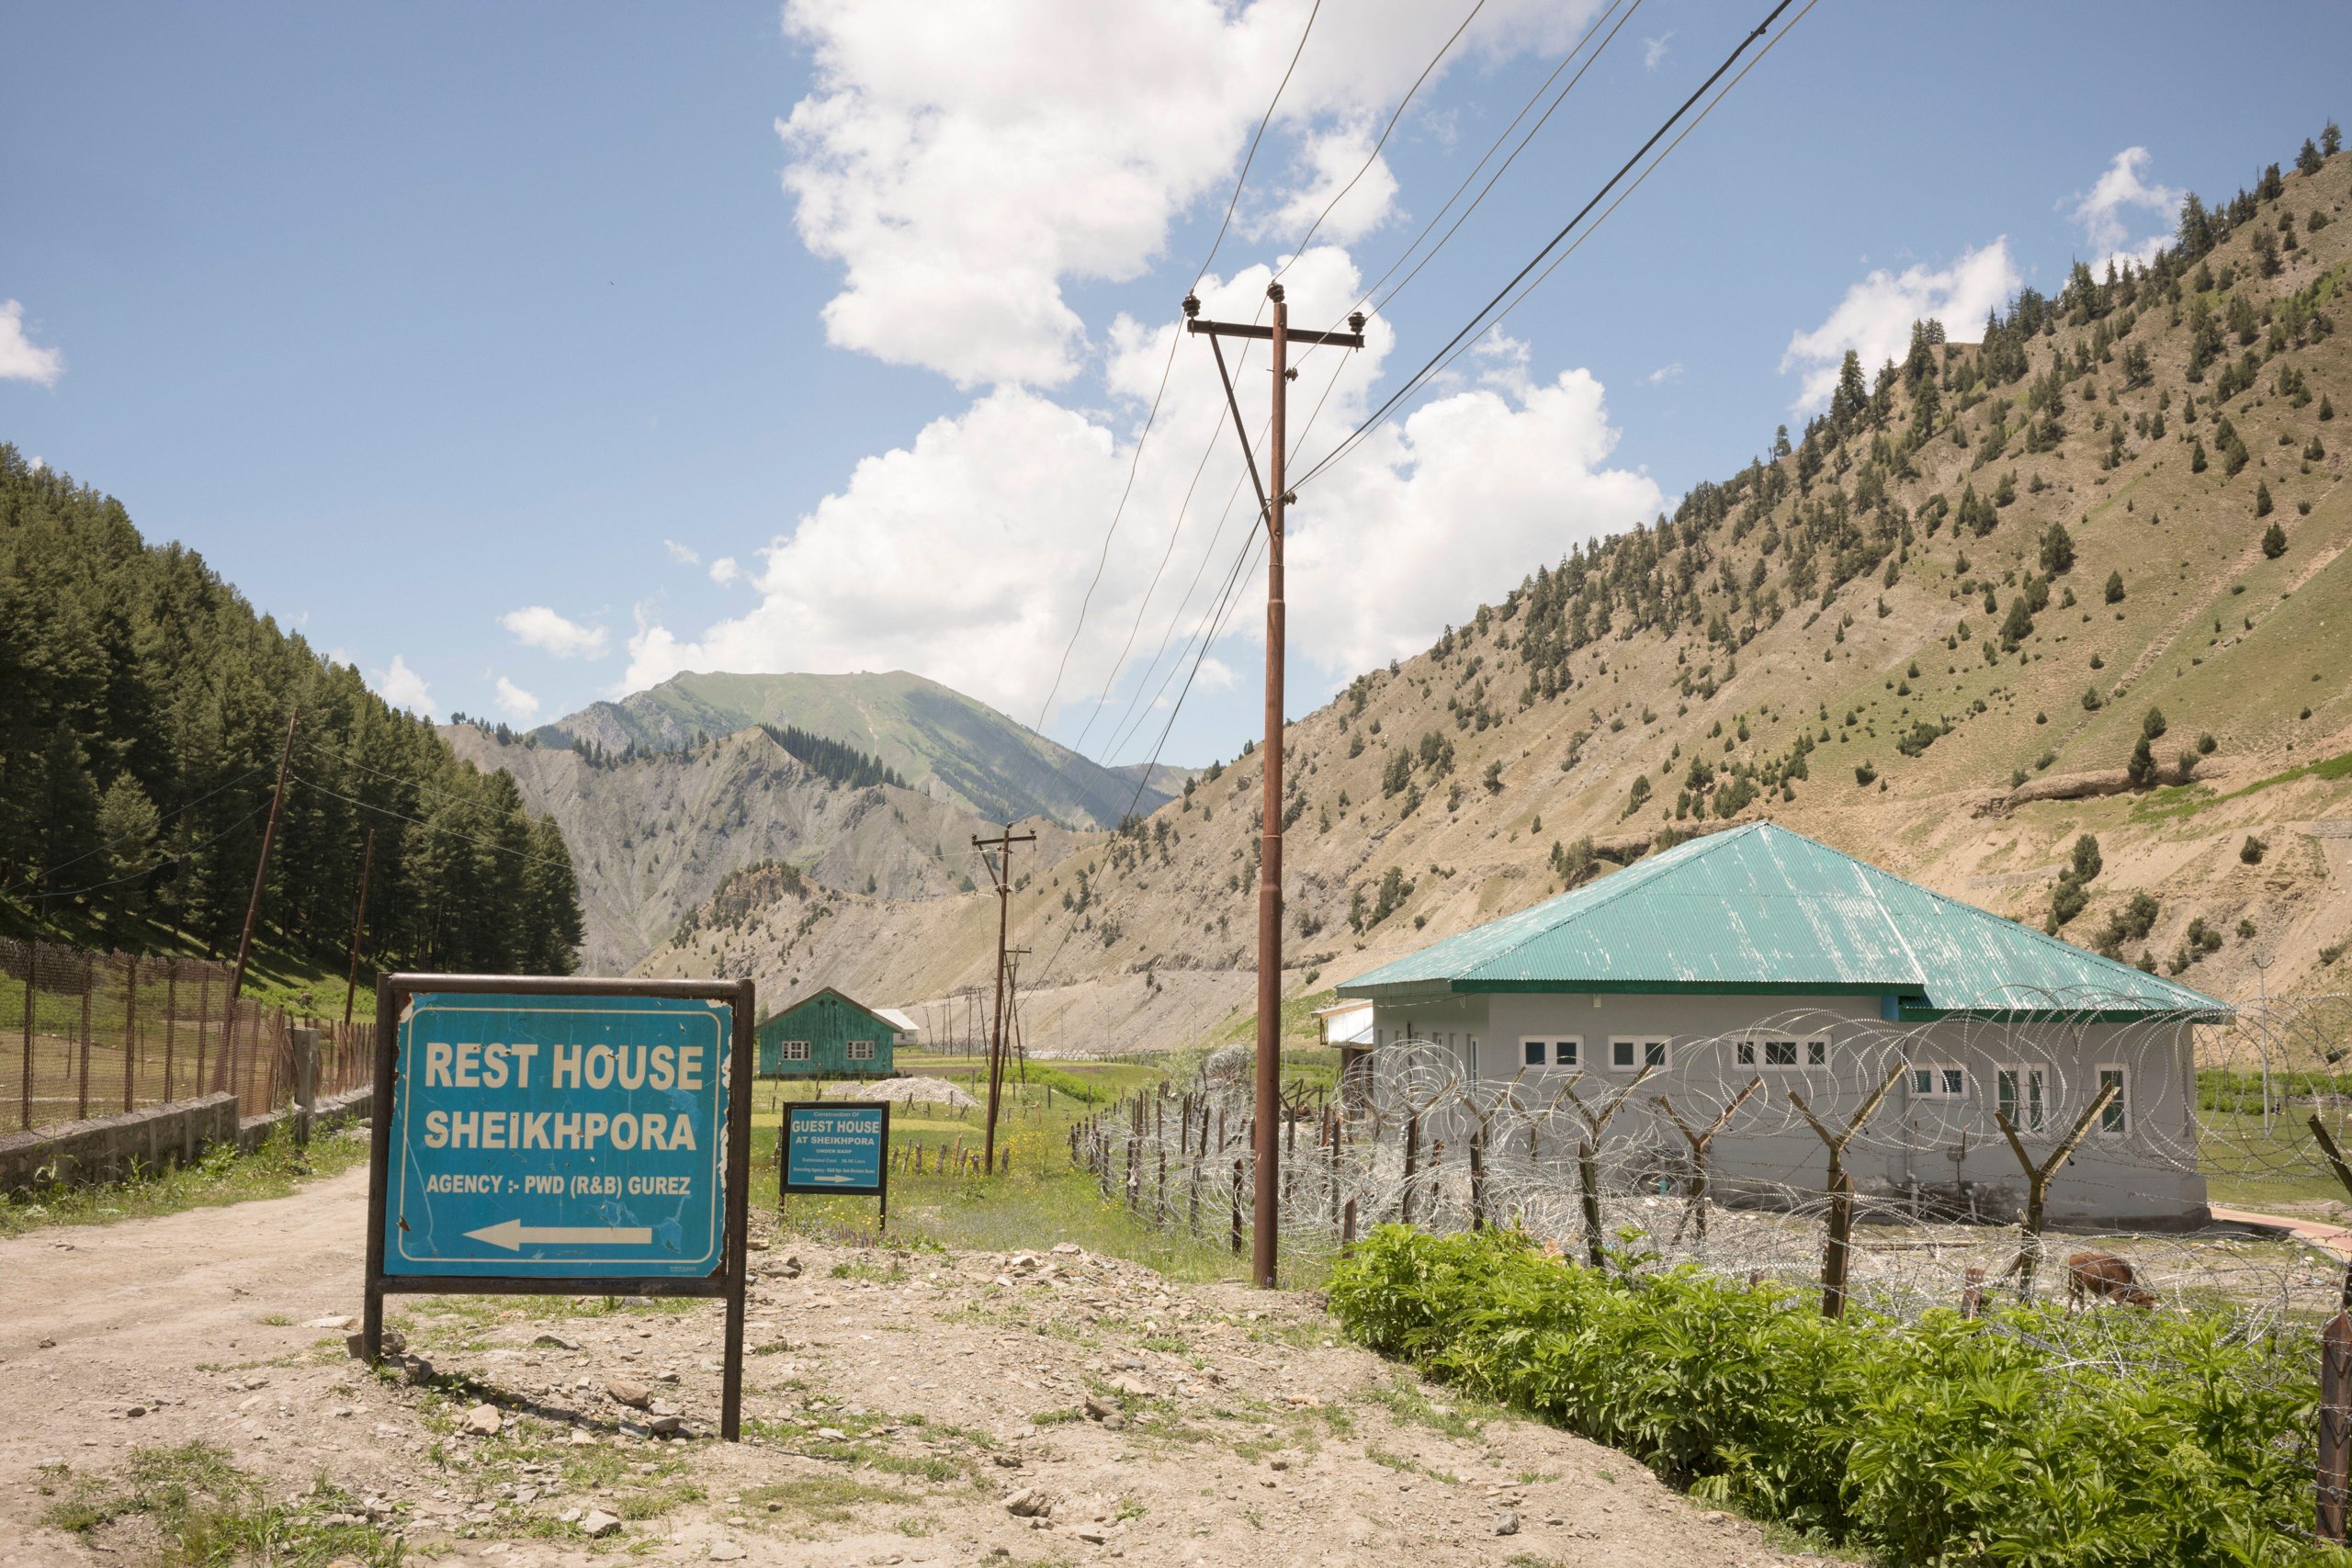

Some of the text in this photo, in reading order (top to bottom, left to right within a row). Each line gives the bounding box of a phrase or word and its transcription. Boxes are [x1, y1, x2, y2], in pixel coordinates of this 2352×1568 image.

[424, 1042, 704, 1090] REST HOUSE
[424, 1110, 697, 1151] SHEIKHPORA
[792, 1120, 880, 1134] GUEST HOUSE
[810, 1136, 875, 1145] SHEIKHPORA
[425, 1174, 503, 1193] AGENCY
[525, 1175, 565, 1194] PWD
[571, 1175, 622, 1200] (R&B)
[628, 1176, 691, 1195] GUREZ
